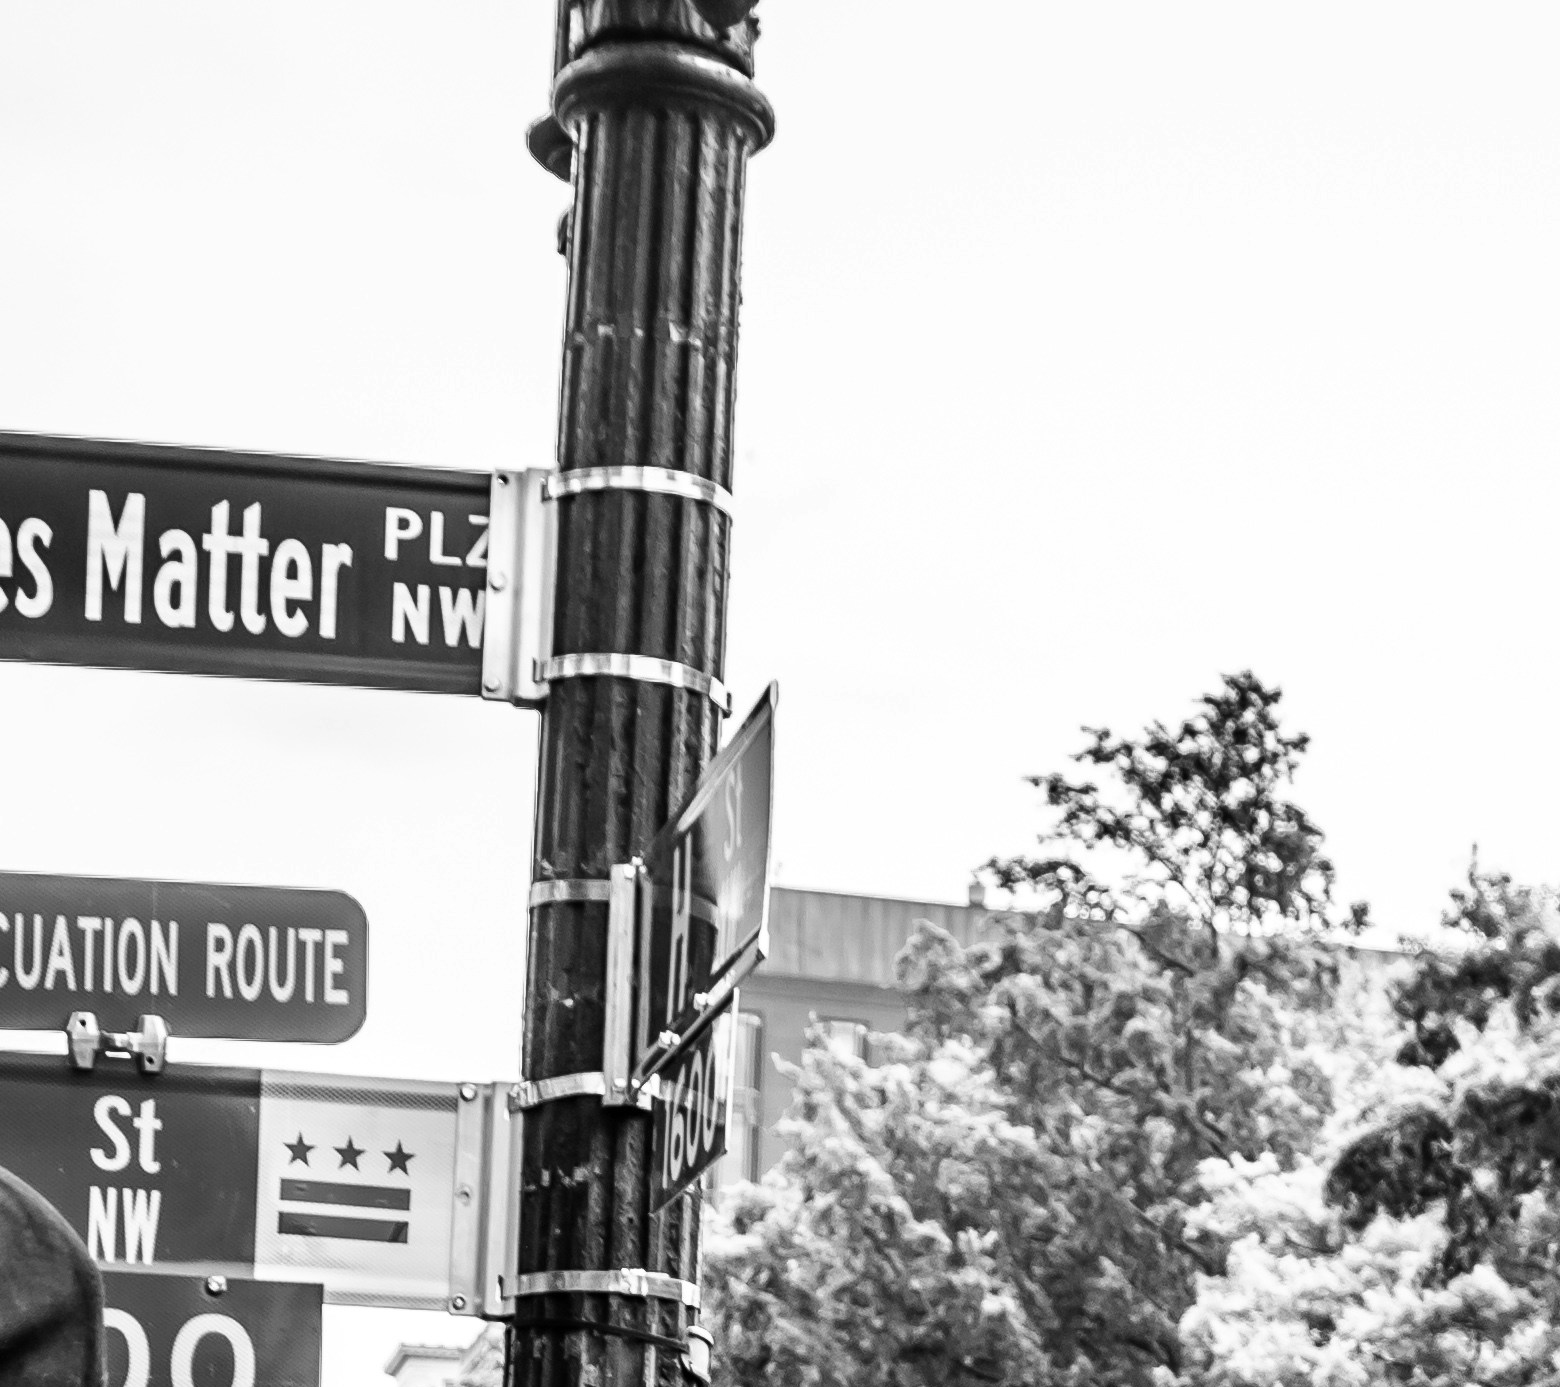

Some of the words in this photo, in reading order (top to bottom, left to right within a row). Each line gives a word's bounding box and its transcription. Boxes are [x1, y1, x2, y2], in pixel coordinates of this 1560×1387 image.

[84, 488, 352, 641] Matter
[382, 506, 492, 570] PLZ
[389, 581, 485, 647] NW
[204, 915, 351, 1005] ROUTE
[91, 1096, 163, 1174] St
[89, 1189, 163, 1268] NW
